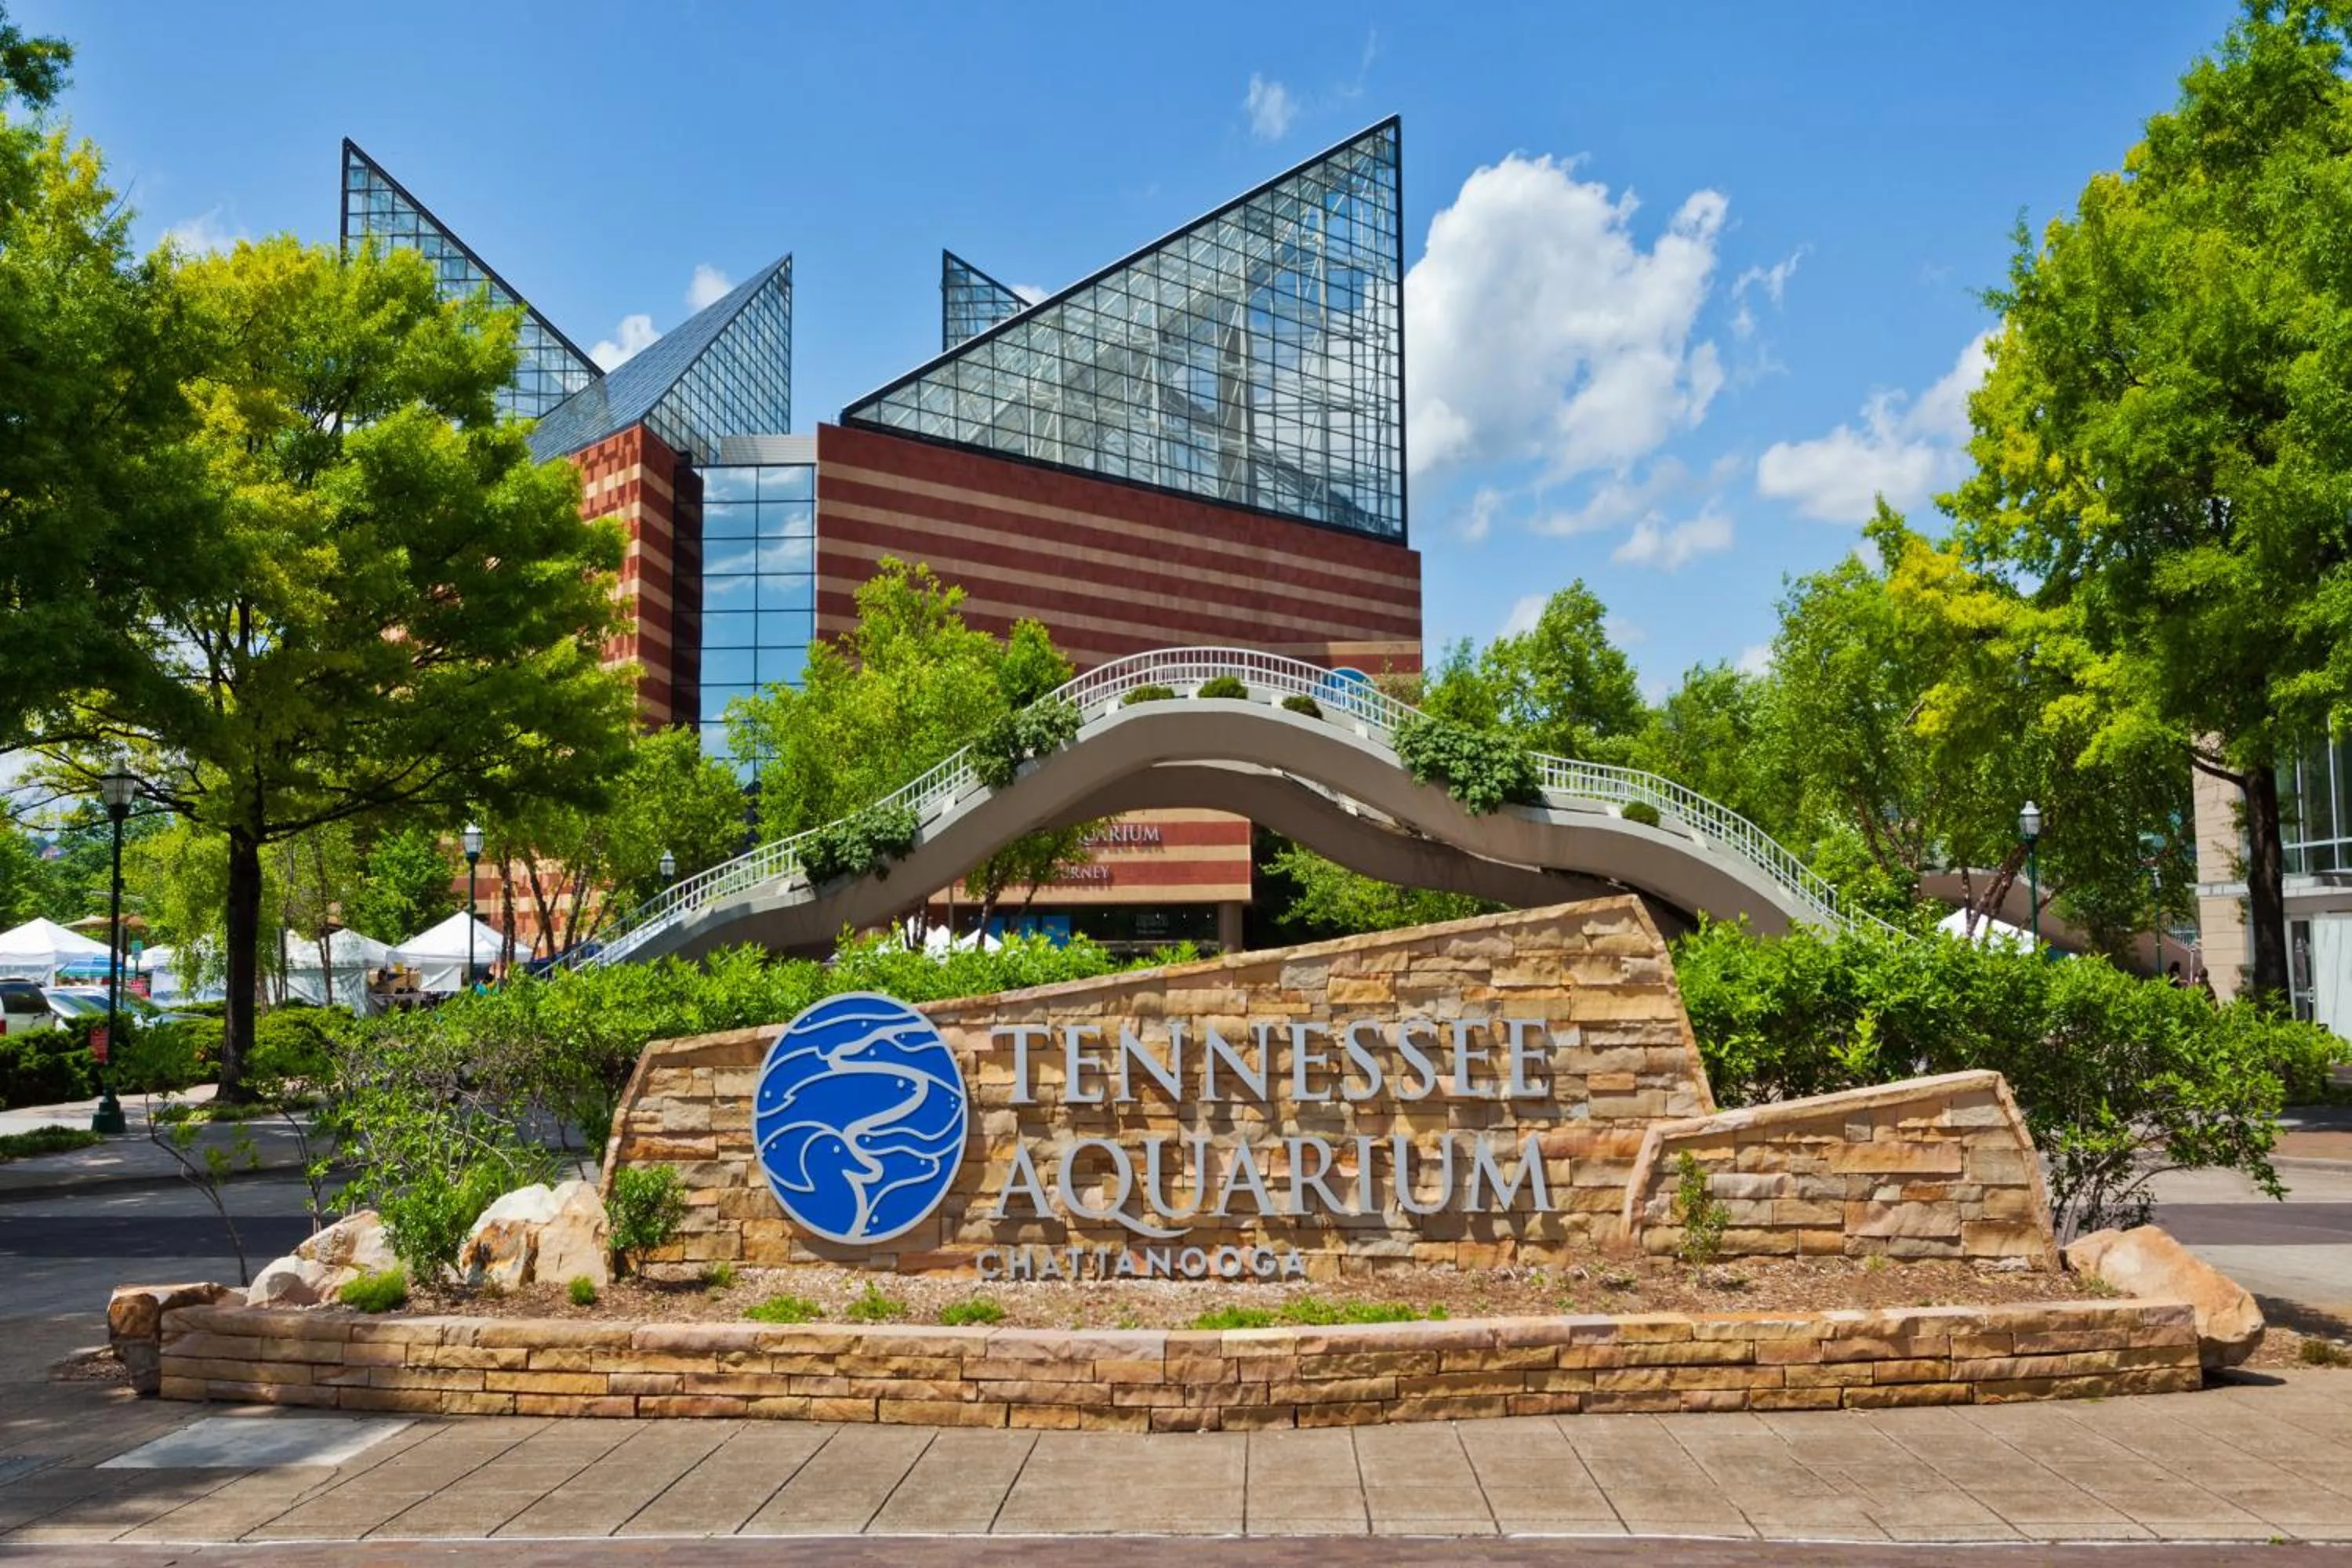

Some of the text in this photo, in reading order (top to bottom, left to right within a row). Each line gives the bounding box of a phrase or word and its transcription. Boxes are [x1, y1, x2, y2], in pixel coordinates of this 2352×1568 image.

[1076, 825, 1160, 845] UARIUM
[1052, 865, 1109, 879] URNEY
[990, 1018, 1550, 1104] TENNESSEE
[986, 1132, 1555, 1239] AQUARIUM
[976, 1246, 1307, 1279] CHATTANOOGA
